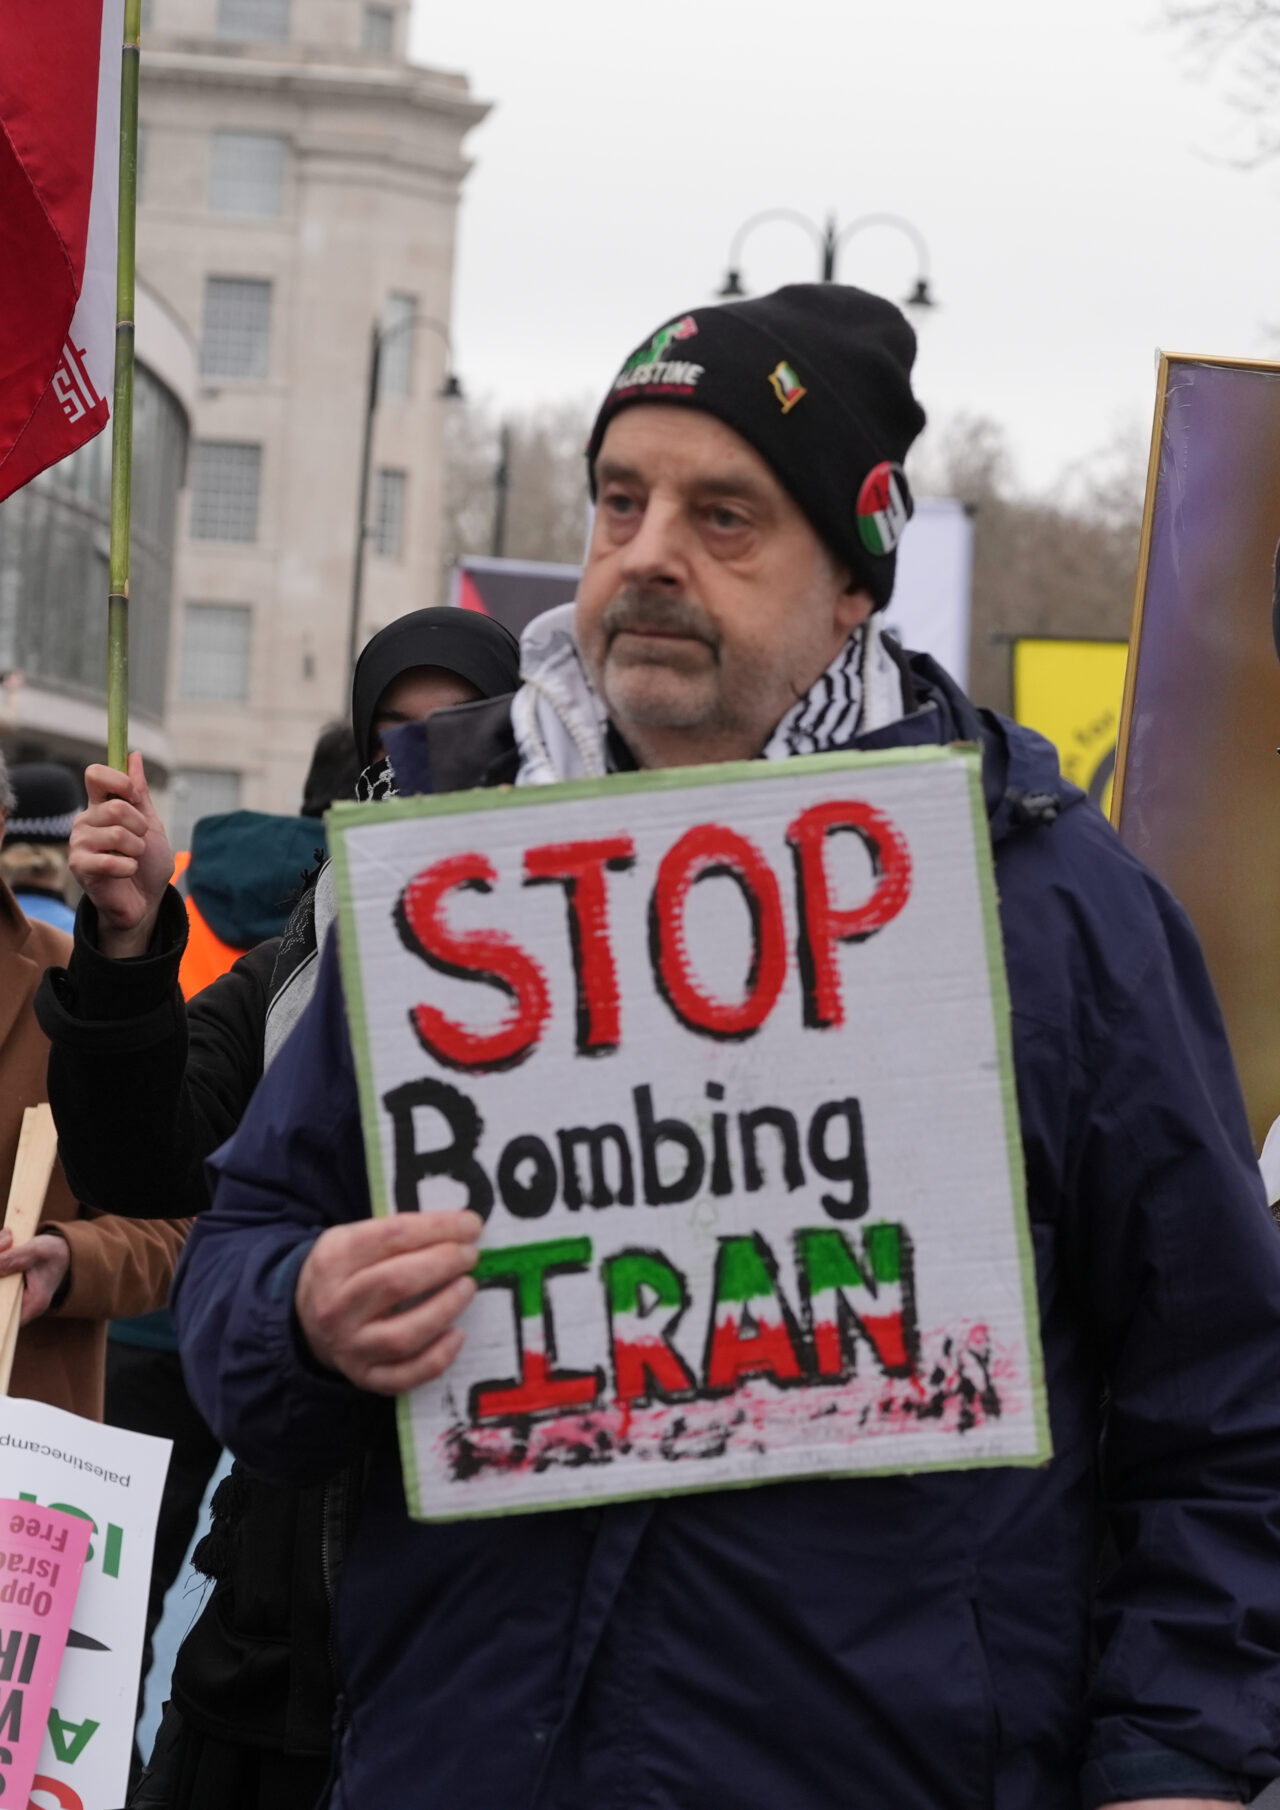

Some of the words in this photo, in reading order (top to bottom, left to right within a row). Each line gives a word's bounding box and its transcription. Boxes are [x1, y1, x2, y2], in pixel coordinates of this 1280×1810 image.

[393, 800, 914, 1075] STOP
[383, 1077, 870, 1227] Bombing
[470, 1218, 921, 1428] IRAN
[10, 1514, 69, 1553] Free
